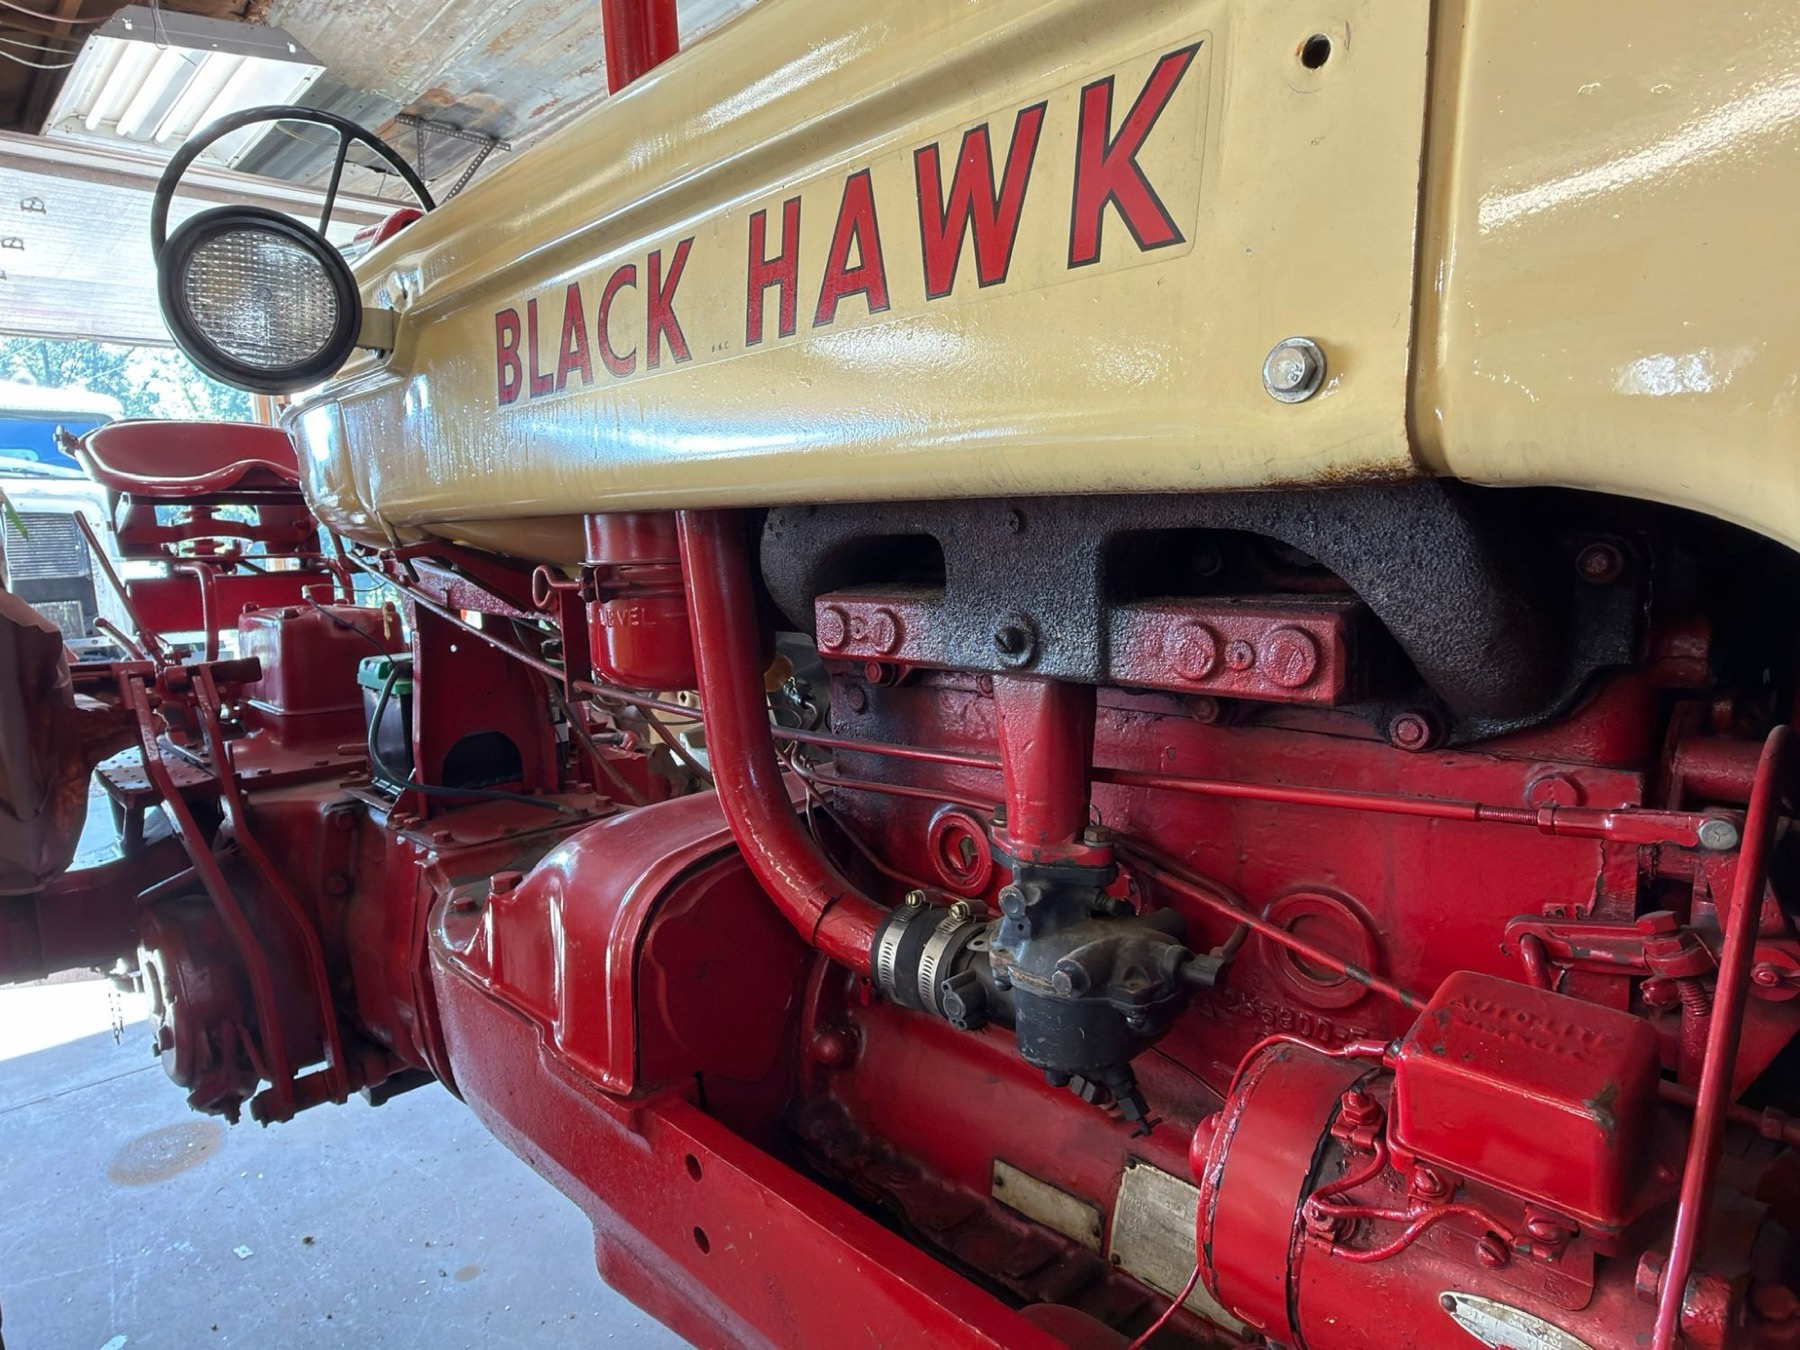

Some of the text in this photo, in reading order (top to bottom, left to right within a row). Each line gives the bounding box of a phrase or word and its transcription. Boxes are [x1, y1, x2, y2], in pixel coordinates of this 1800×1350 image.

[495, 40, 1205, 407] BLACK HAWK
[598, 606, 656, 627] LEVEL
